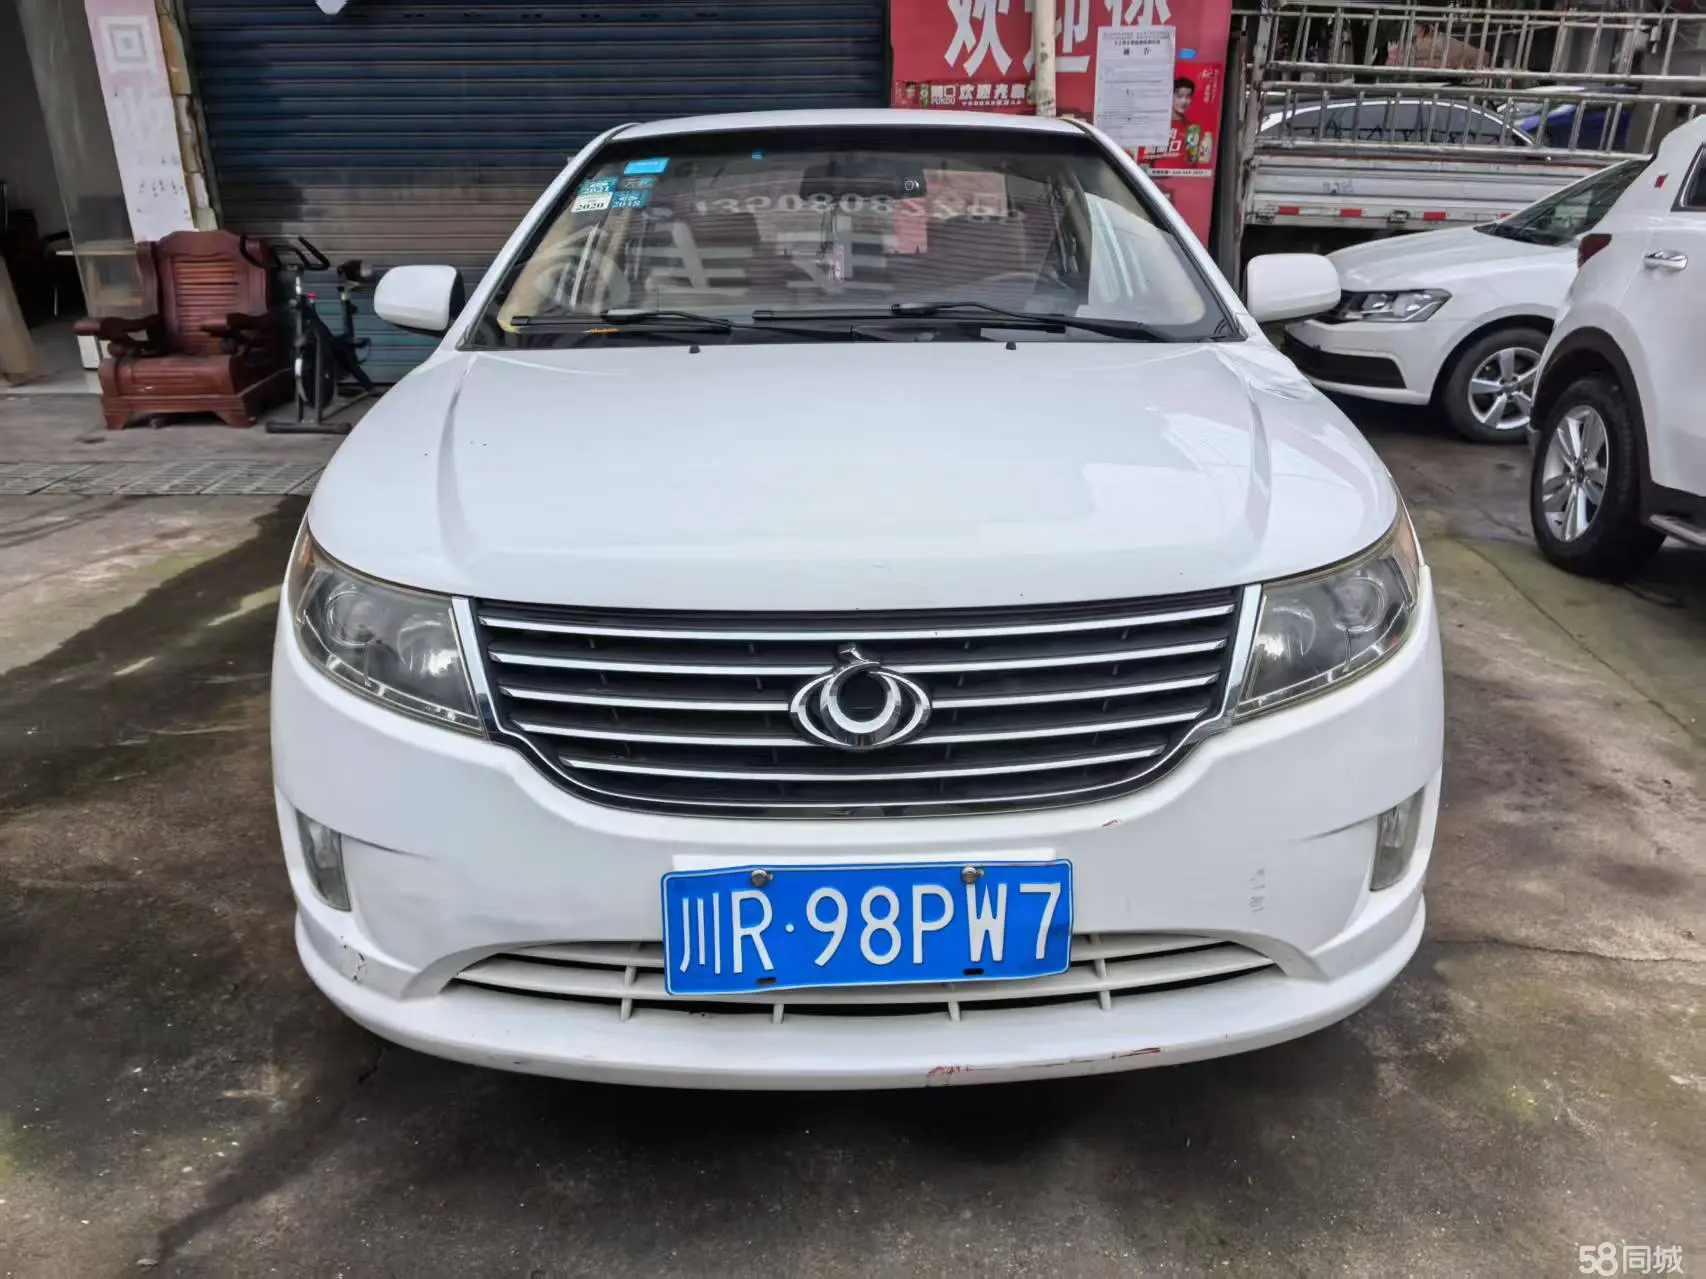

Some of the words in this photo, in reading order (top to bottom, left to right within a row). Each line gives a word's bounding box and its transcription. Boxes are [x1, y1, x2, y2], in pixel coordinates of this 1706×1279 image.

[576, 203, 604, 211] 2020
[612, 200, 641, 208] 2018
[679, 882, 1061, 975] 川R·98PW7
